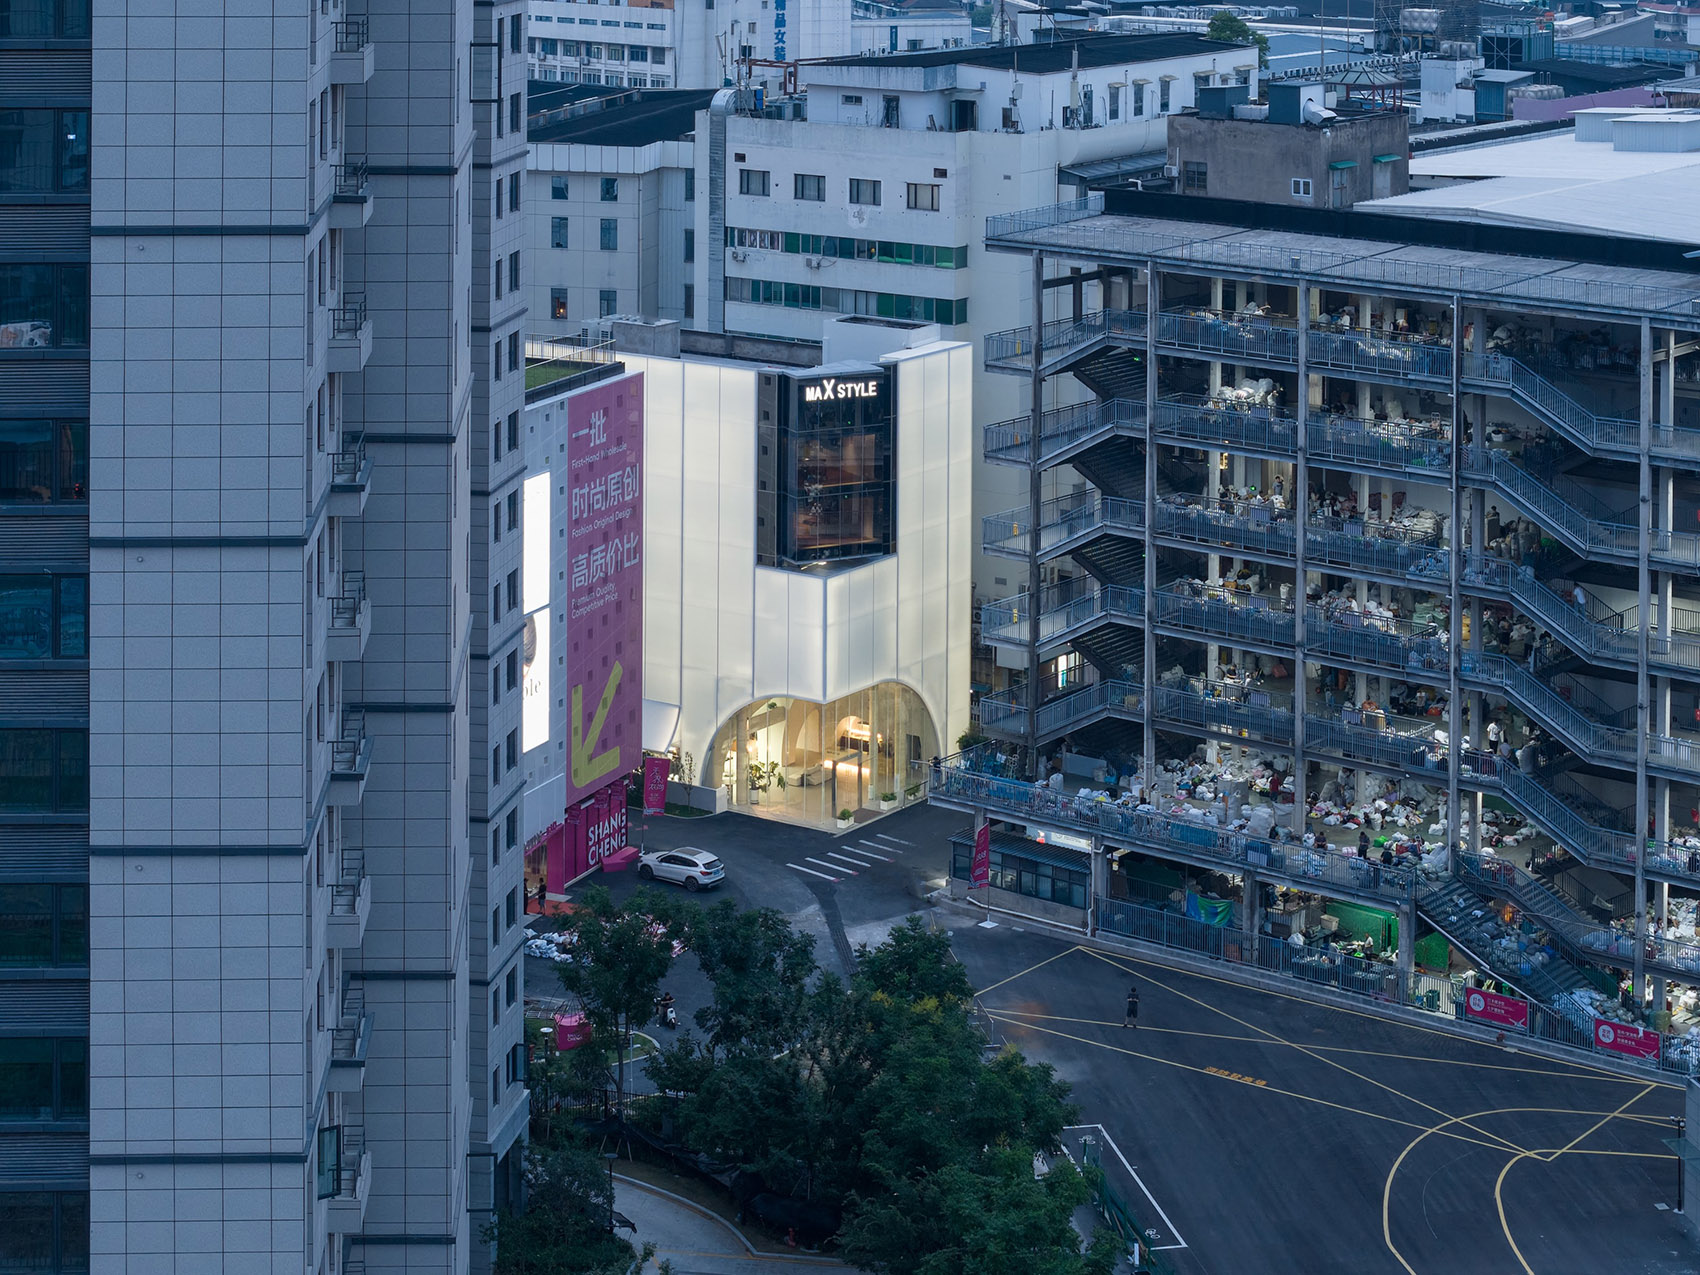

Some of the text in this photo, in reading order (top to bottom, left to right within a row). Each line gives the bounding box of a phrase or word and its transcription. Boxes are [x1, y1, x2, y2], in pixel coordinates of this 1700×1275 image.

[805, 379, 878, 402] MAX STYLE
[572, 409, 607, 448] 一批
[572, 451, 600, 470] First-Hand
[572, 463, 640, 521] 时尚原创
[571, 523, 593, 539] Fashion
[594, 513, 614, 529] Original
[572, 532, 640, 592] 高质价比
[572, 592, 619, 619] Competitive Price
[588, 808, 626, 846] SHANG
[588, 828, 626, 866] CHENG
